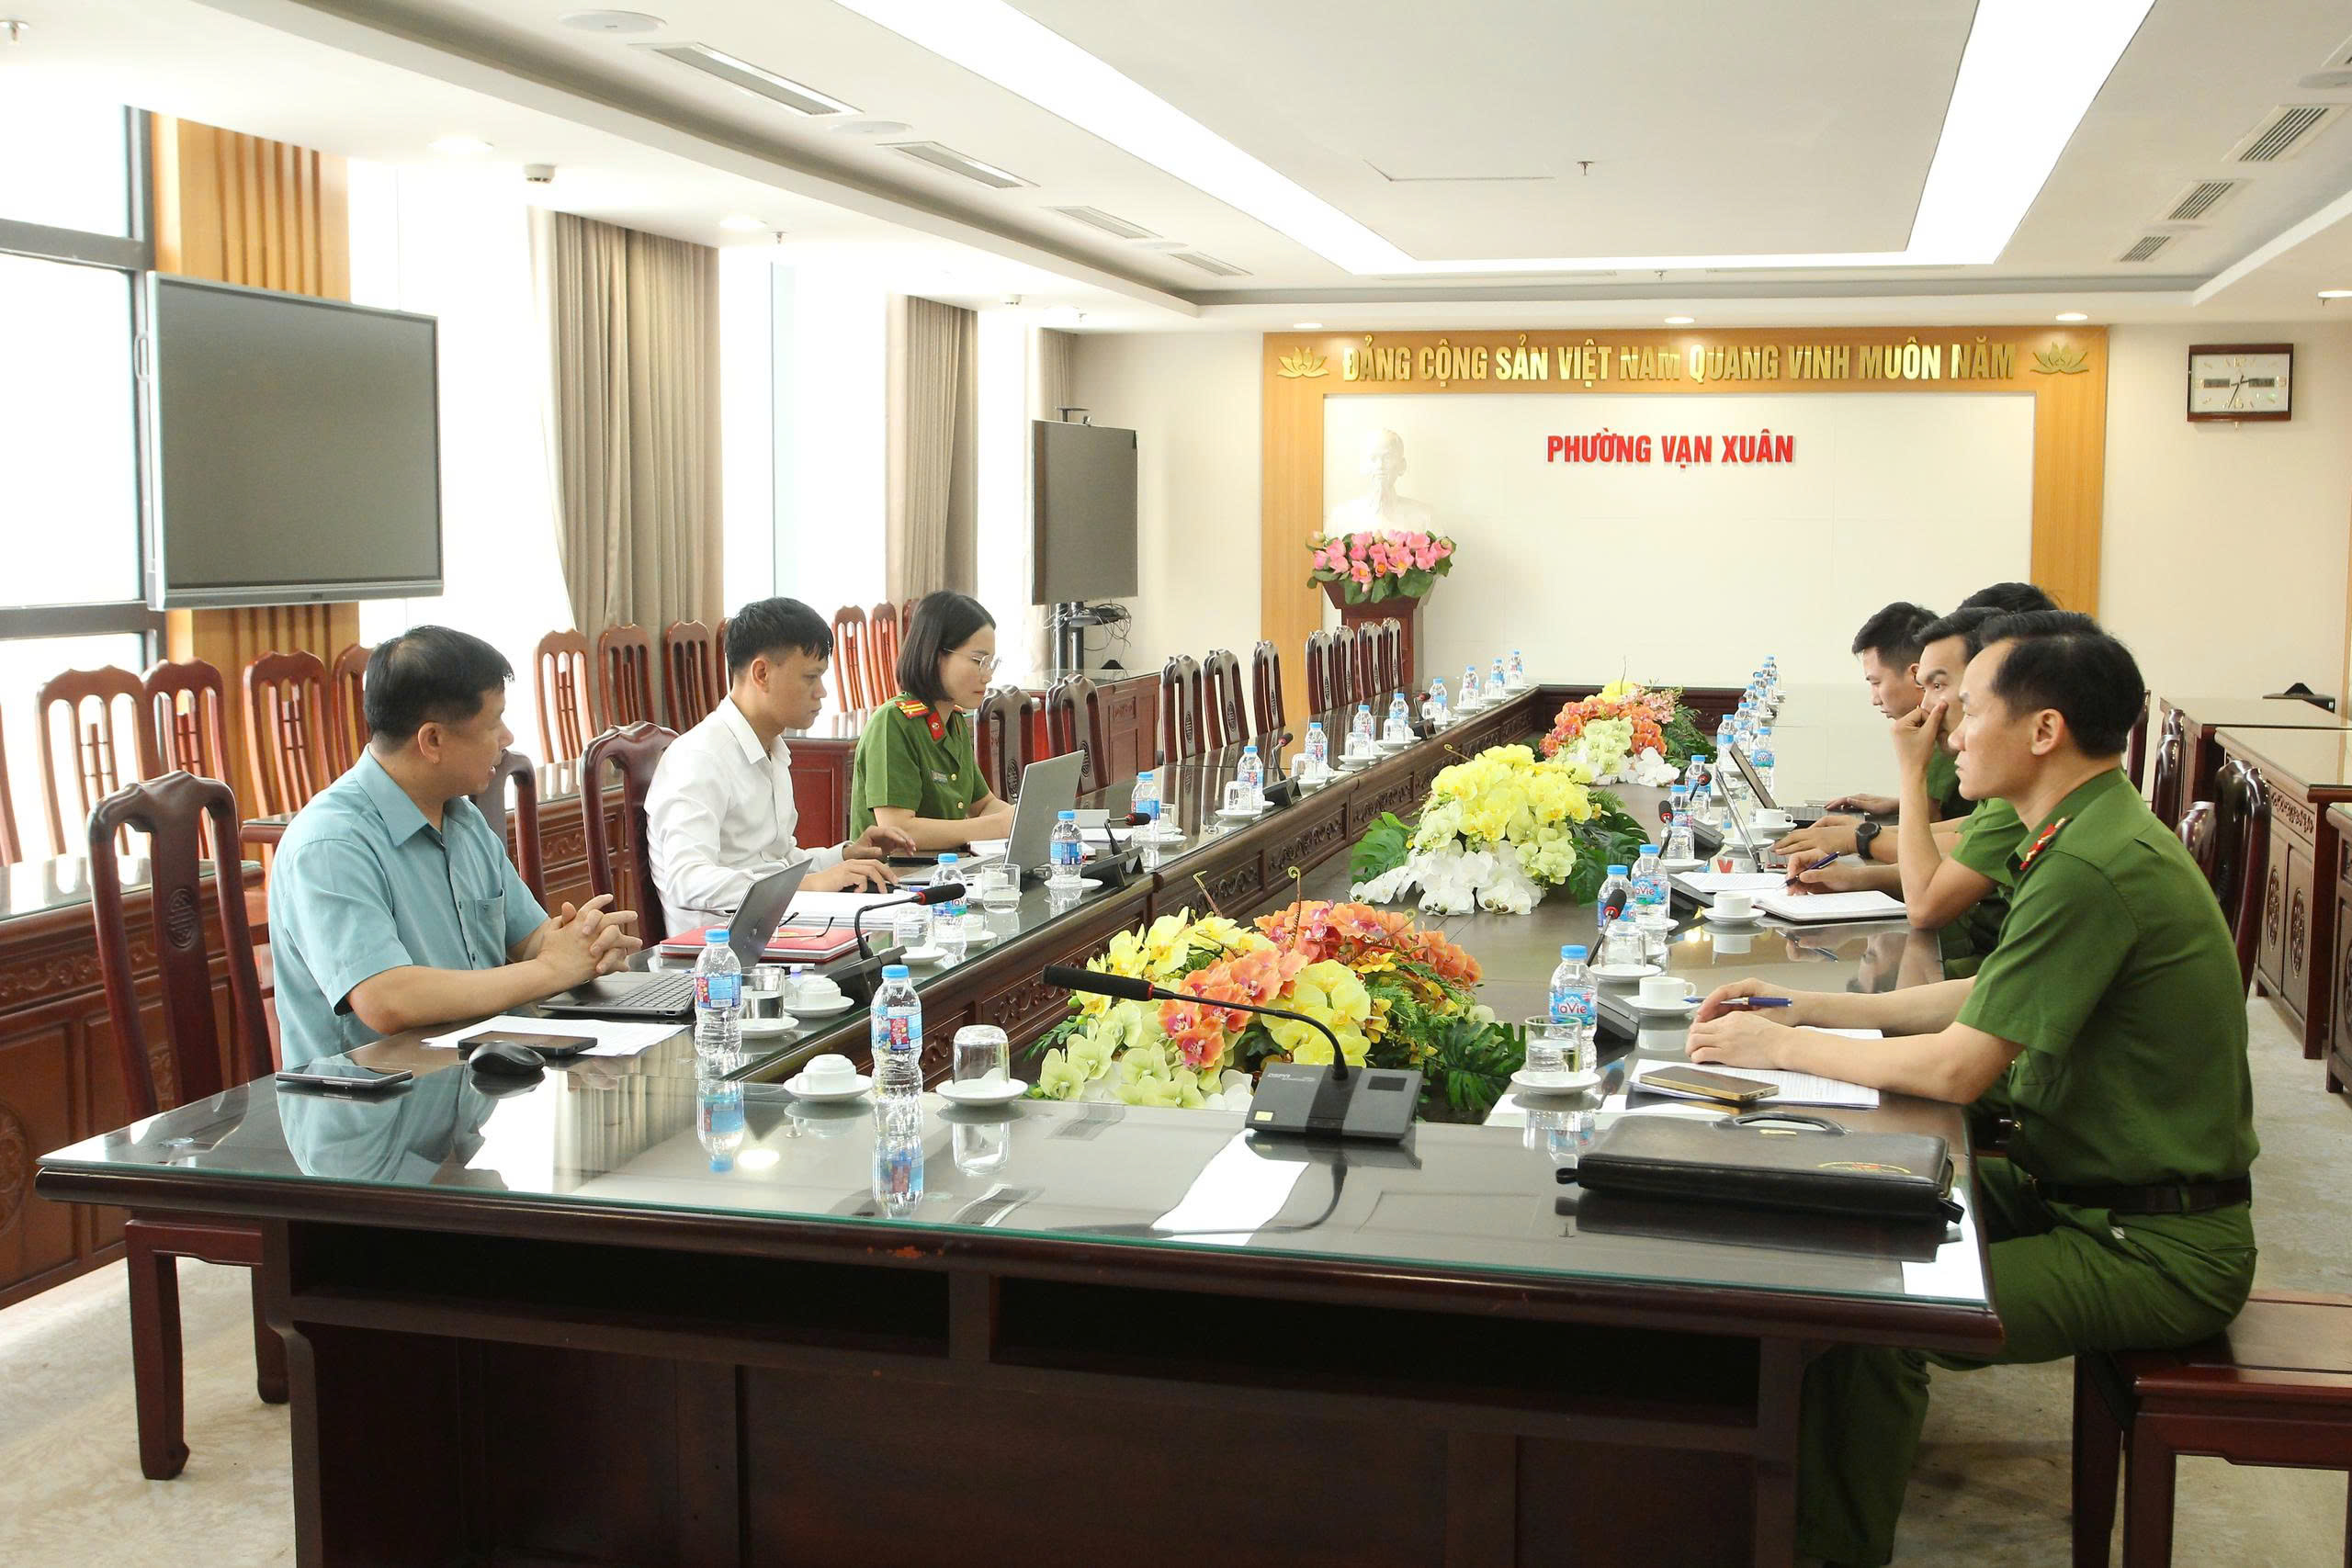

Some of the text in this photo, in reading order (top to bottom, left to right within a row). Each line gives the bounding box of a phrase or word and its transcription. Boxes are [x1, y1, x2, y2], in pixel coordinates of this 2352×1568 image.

[1342, 333, 2017, 388] ĐẢNG CỘNG SẢN VIỆT NAM QUANG VINH MUÔN NĂM
[1547, 427, 1793, 469] PHƯỜNG VẠN XUÂN
